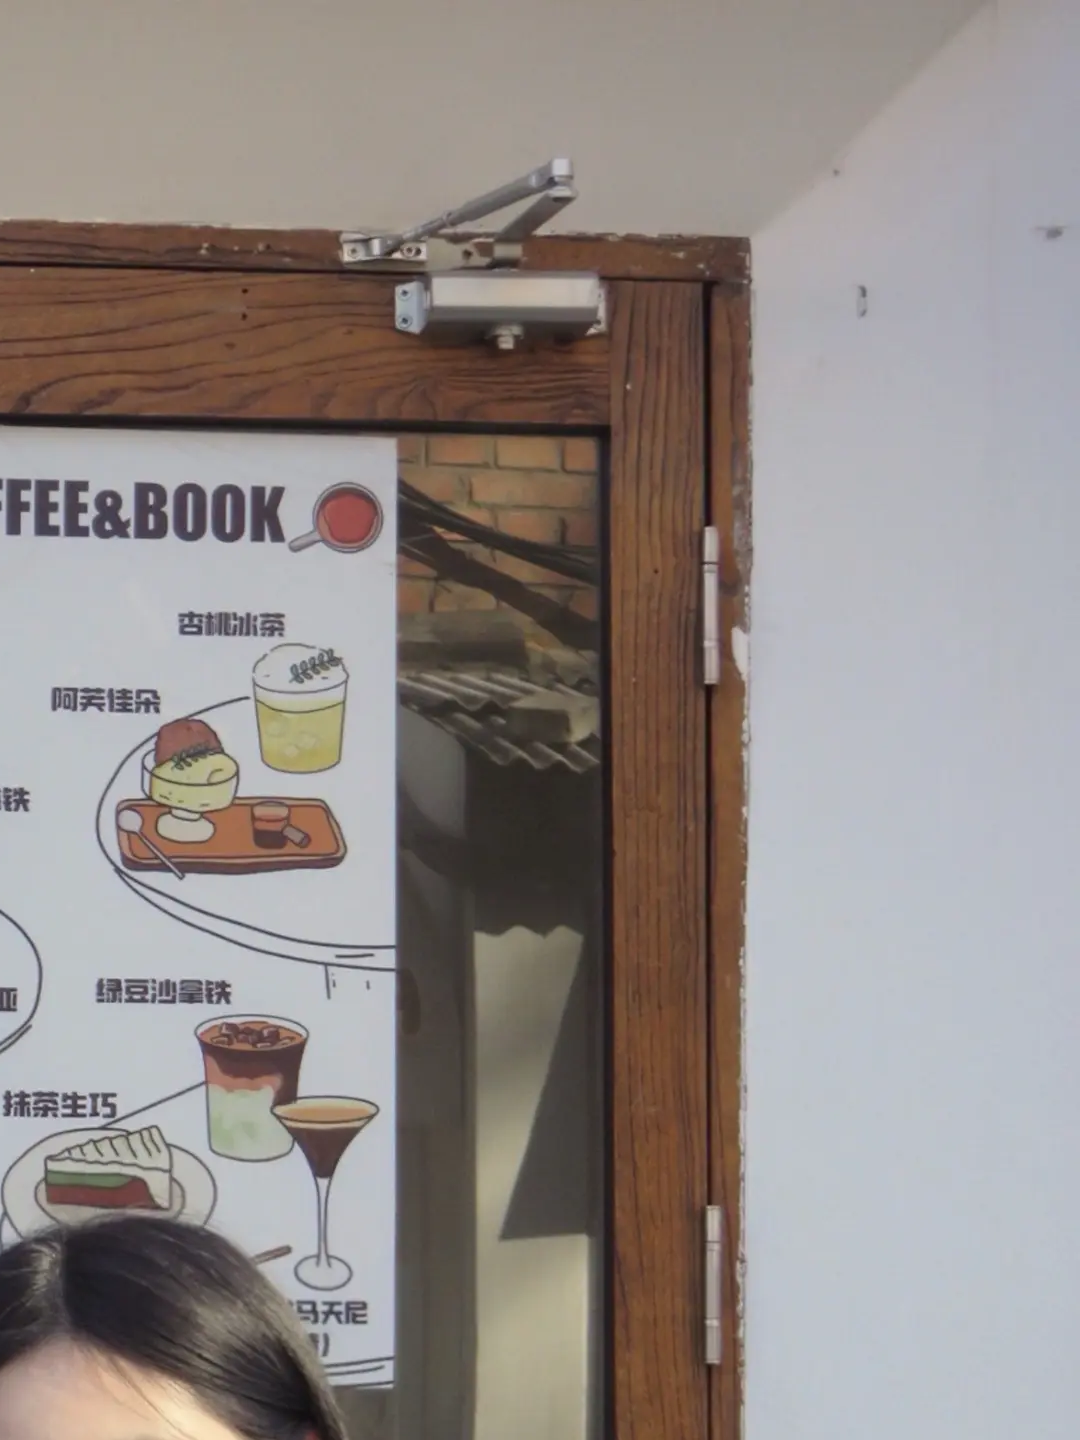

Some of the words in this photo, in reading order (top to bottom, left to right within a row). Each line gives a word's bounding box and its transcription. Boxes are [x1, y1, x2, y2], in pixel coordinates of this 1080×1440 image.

[178, 611, 286, 637] 杏桃冰茶
[51, 687, 161, 714] 阿芙佳朵
[95, 978, 232, 1005] 绿豆沙拿铁
[3, 1090, 117, 1118] 抹茶生巧
[287, 1300, 368, 1325] 马天尼
